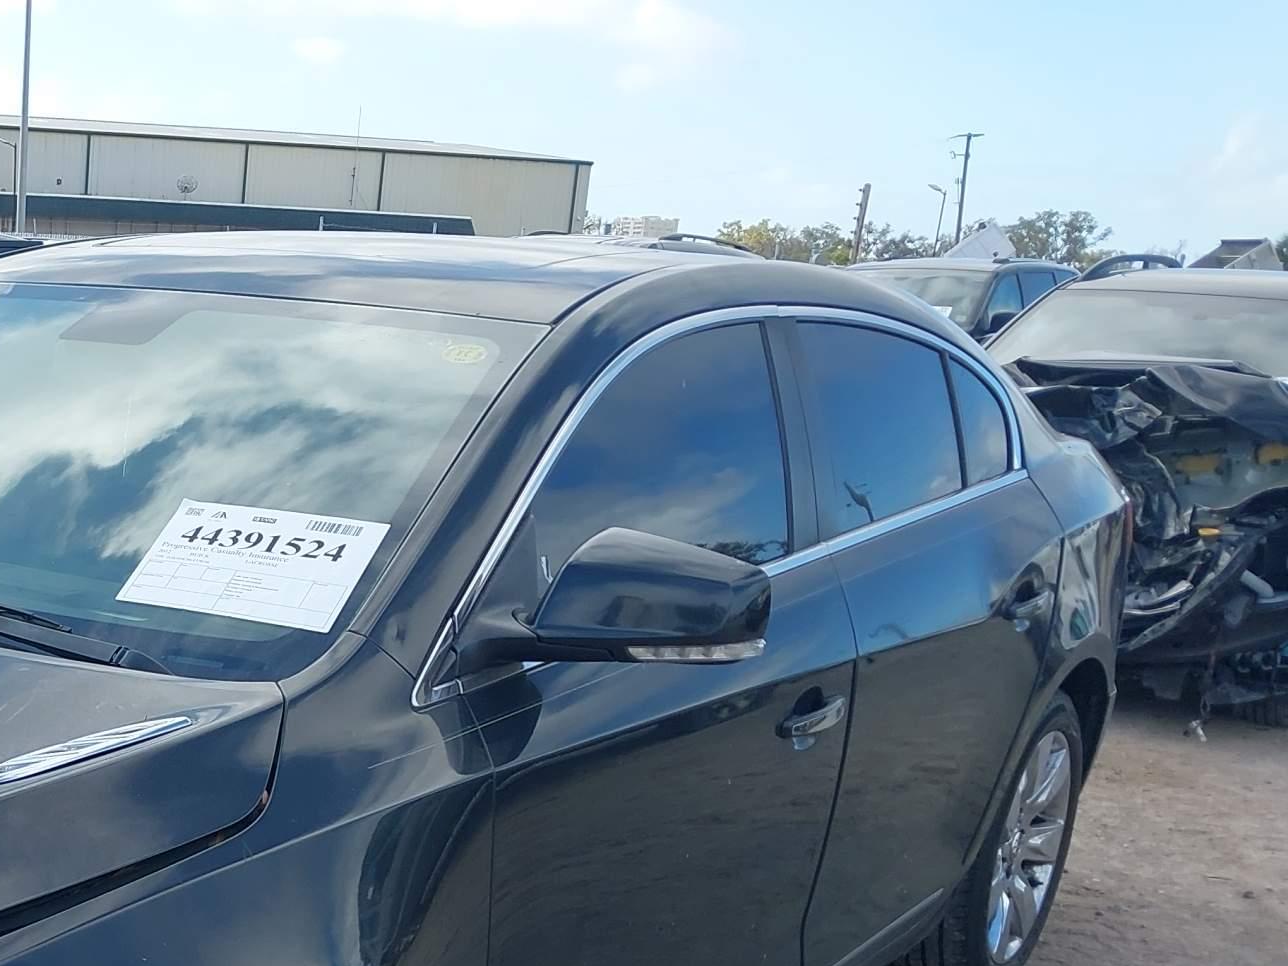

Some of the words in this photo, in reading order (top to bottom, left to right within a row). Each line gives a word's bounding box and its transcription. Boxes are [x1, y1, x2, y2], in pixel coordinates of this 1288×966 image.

[161, 541, 209, 552] Progressive
[210, 547, 246, 558] Casualty
[248, 551, 289, 563] Insurance
[181, 525, 347, 562] 44391524
